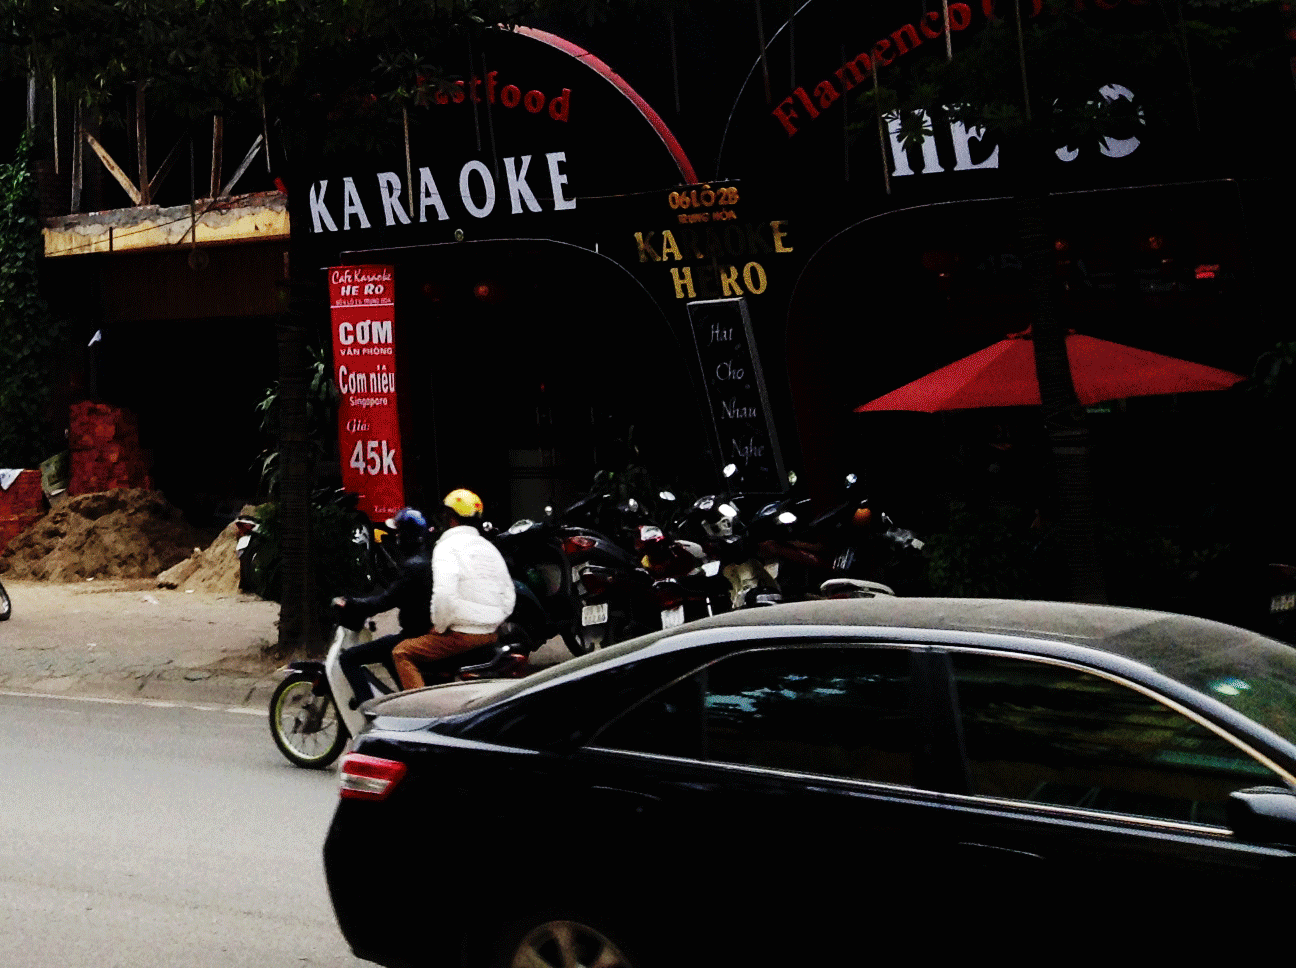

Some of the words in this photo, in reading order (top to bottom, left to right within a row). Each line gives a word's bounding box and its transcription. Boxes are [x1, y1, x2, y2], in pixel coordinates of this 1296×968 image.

[771, 2, 971, 138] Flamenco
[309, 151, 577, 233] KARAOKE
[331, 270, 353, 284] Cafe
[338, 319, 393, 346] CƠM
[338, 365, 367, 394] Cơm
[715, 359, 745, 380] Cho
[721, 395, 757, 420] Nhau
[349, 439, 398, 476] 45k
[731, 435, 766, 466] Nghe
